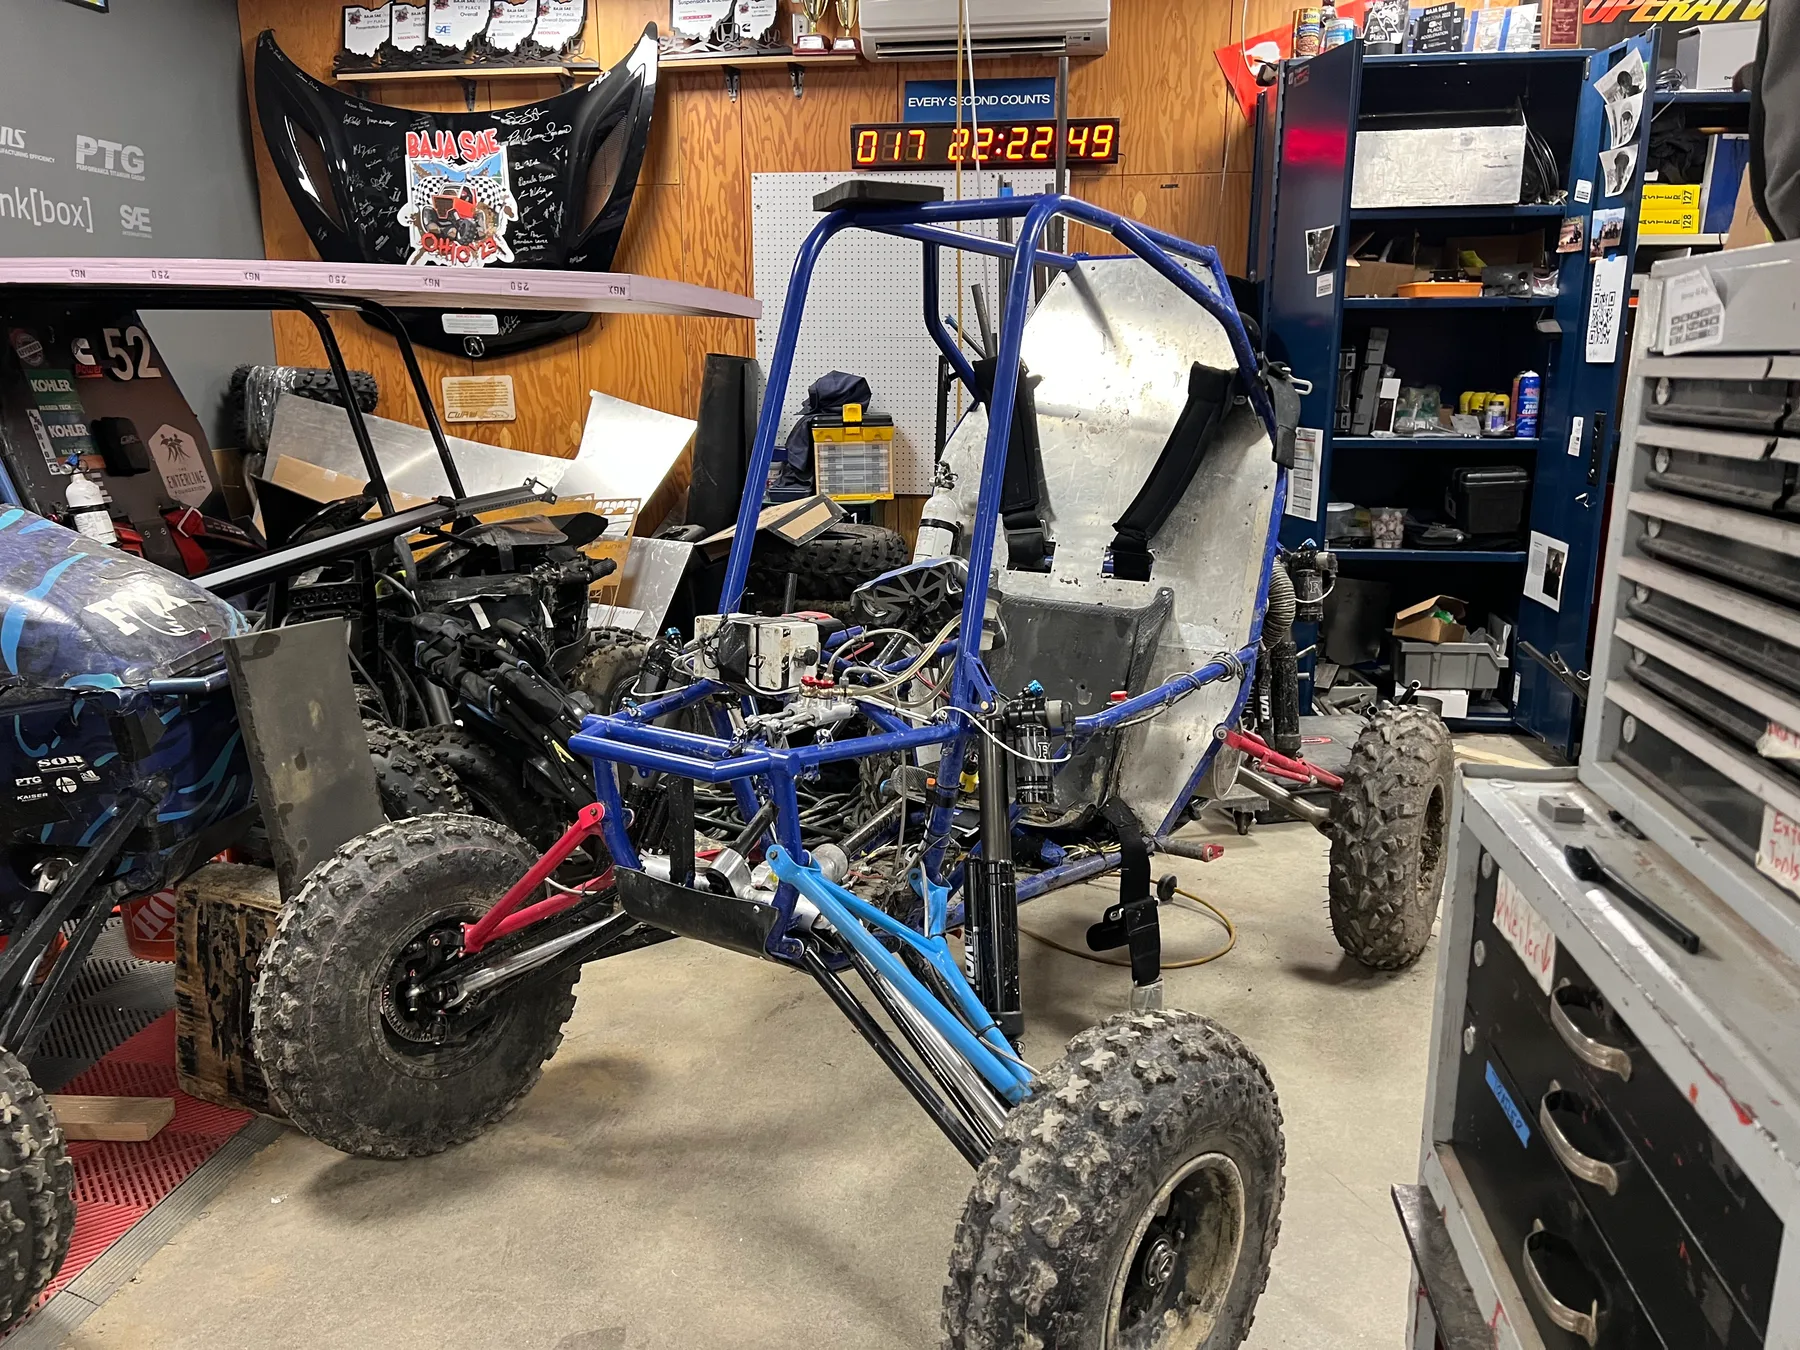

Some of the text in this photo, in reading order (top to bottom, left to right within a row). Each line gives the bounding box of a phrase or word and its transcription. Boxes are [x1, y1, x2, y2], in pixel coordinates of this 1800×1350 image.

[435, 25, 451, 34] SAE
[908, 93, 1050, 107] EVERY SECOND COUNTS
[405, 129, 459, 160] BAJA
[458, 128, 500, 161] SAE
[76, 134, 145, 174] PTG
[1682, 190, 1693, 205] 127
[119, 204, 152, 232] SAE
[1682, 214, 1692, 229] 128
[151, 270, 170, 279] 250
[328, 274, 347, 284] 250
[510, 281, 529, 291] 250
[103, 326, 162, 381] 52
[30, 379, 74, 392] KOHLER
[48, 423, 91, 438] KOHLER
[166, 470, 206, 489] ENTERLINE
[15, 776, 42, 787] PTG
[17, 792, 48, 801] KAISER
